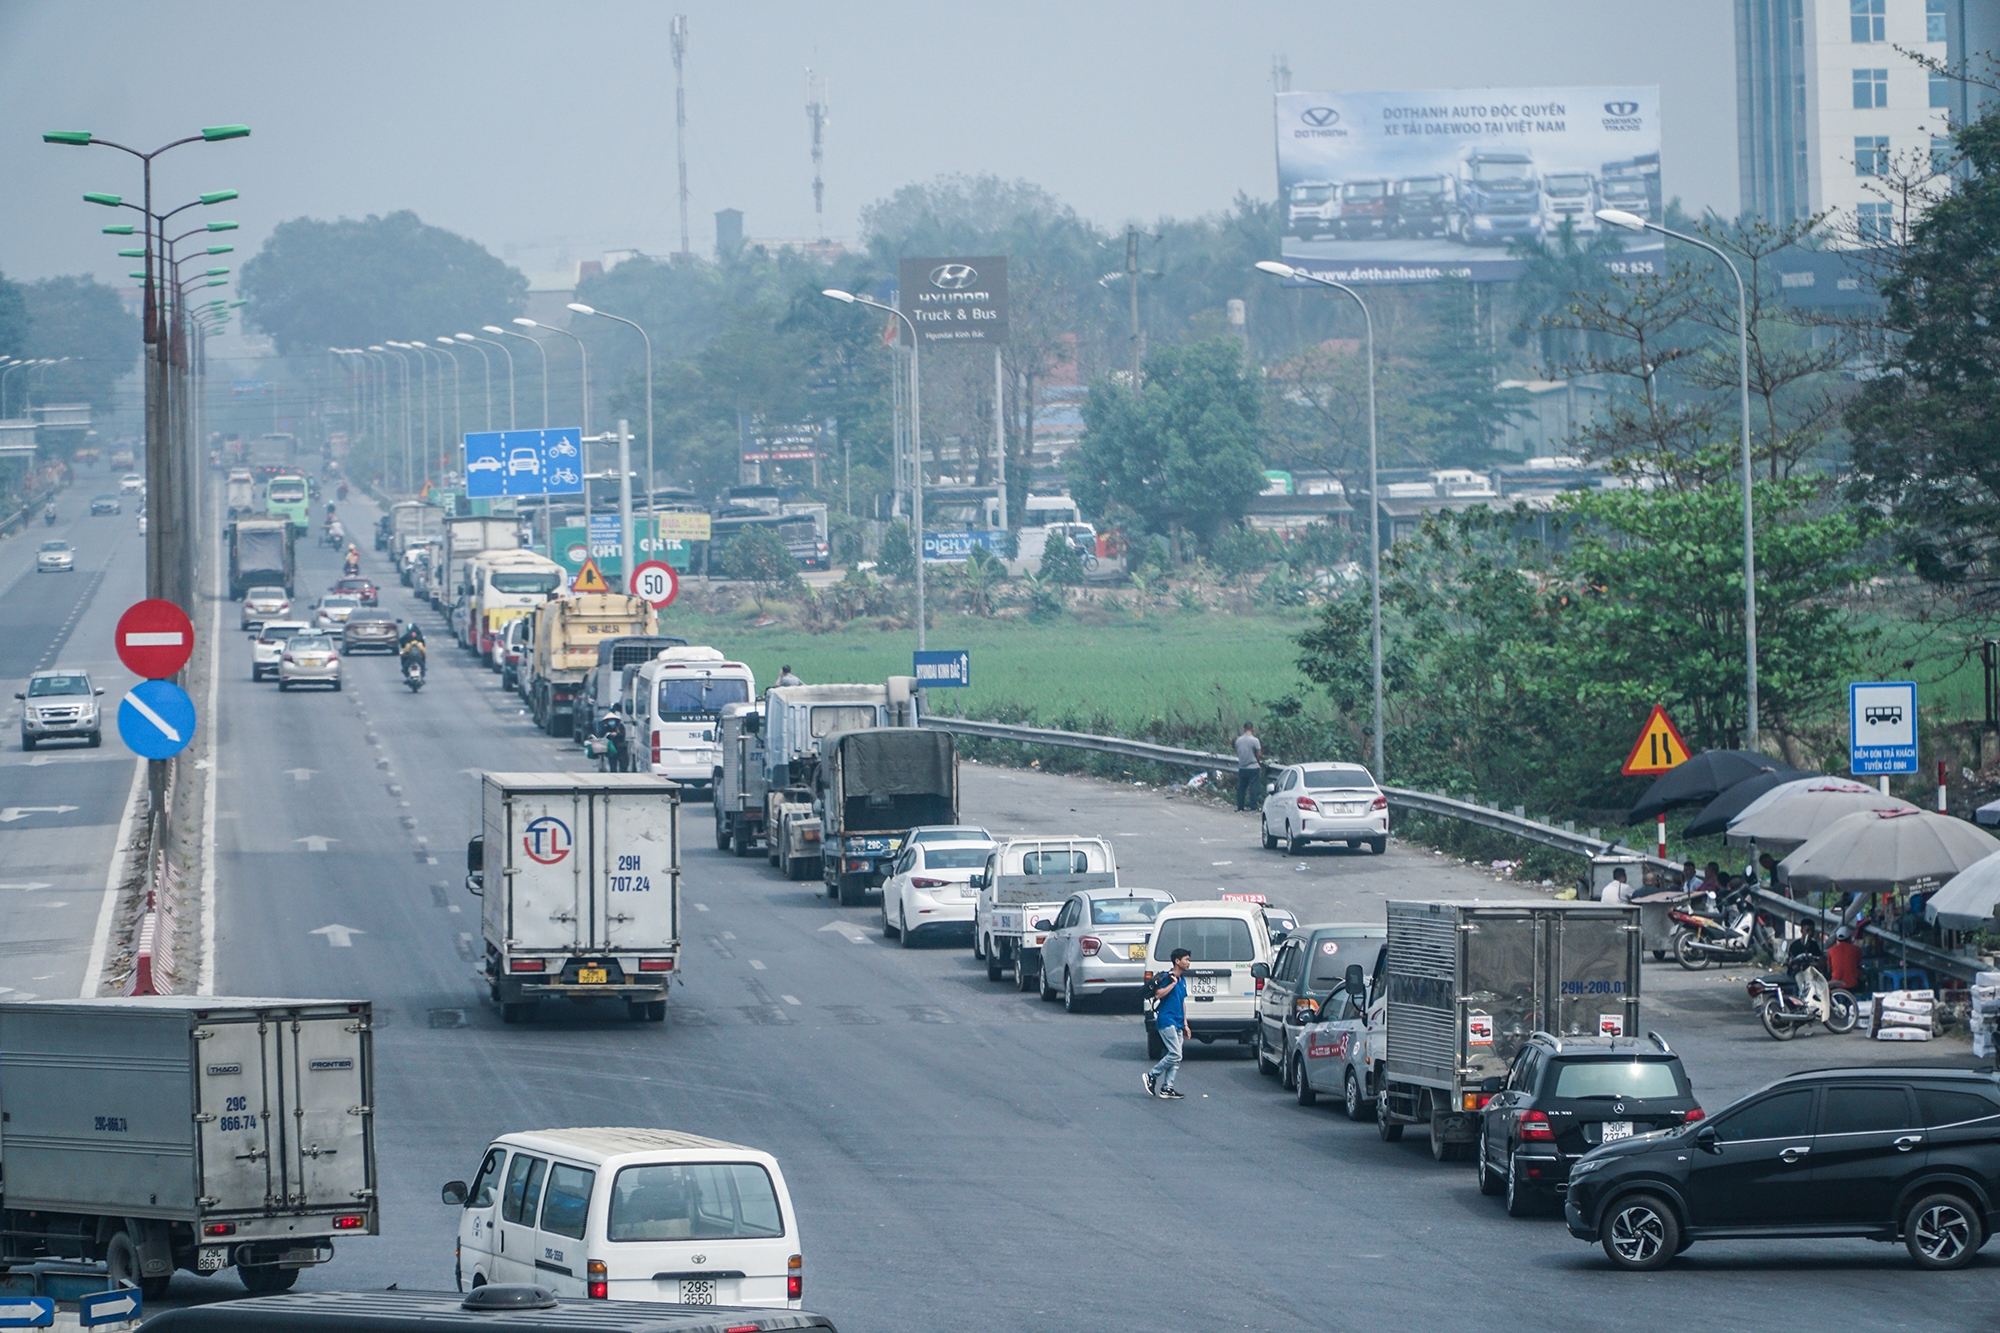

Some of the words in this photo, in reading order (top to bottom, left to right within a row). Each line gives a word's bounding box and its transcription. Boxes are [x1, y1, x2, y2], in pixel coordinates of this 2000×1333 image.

[1383, 106, 1448, 119] DOTHANH
[1452, 106, 1487, 118] AUTO
[1490, 103, 1518, 120] ĐỘC
[1384, 124, 1400, 136] XE
[1424, 122, 1482, 135] DAEWOO
[1484, 122, 1503, 136] TẠI
[1506, 120, 1533, 136] VIỆT
[1536, 120, 1566, 132] NAM
[919, 292, 989, 304] HYUNDAI
[913, 308, 952, 321] Truck
[957, 308, 967, 320] &
[972, 308, 997, 320] Bus
[592, 544, 630, 558] GHT
[645, 574, 662, 594] 50
[618, 856, 640, 871] 29H
[610, 876, 650, 892] 707.24
[1246, 894, 1262, 903] 123
[1561, 981, 1626, 994] 29H-200.01
[226, 1096, 246, 1112] 29C
[220, 1115, 256, 1132] 866.74
[1610, 1122, 1626, 1132] 30F
[206, 1250, 222, 1258] 29C
[200, 1258, 226, 1269] 866.74
[688, 1281, 708, 1292] 29S
[684, 1293, 712, 1304] 3550
